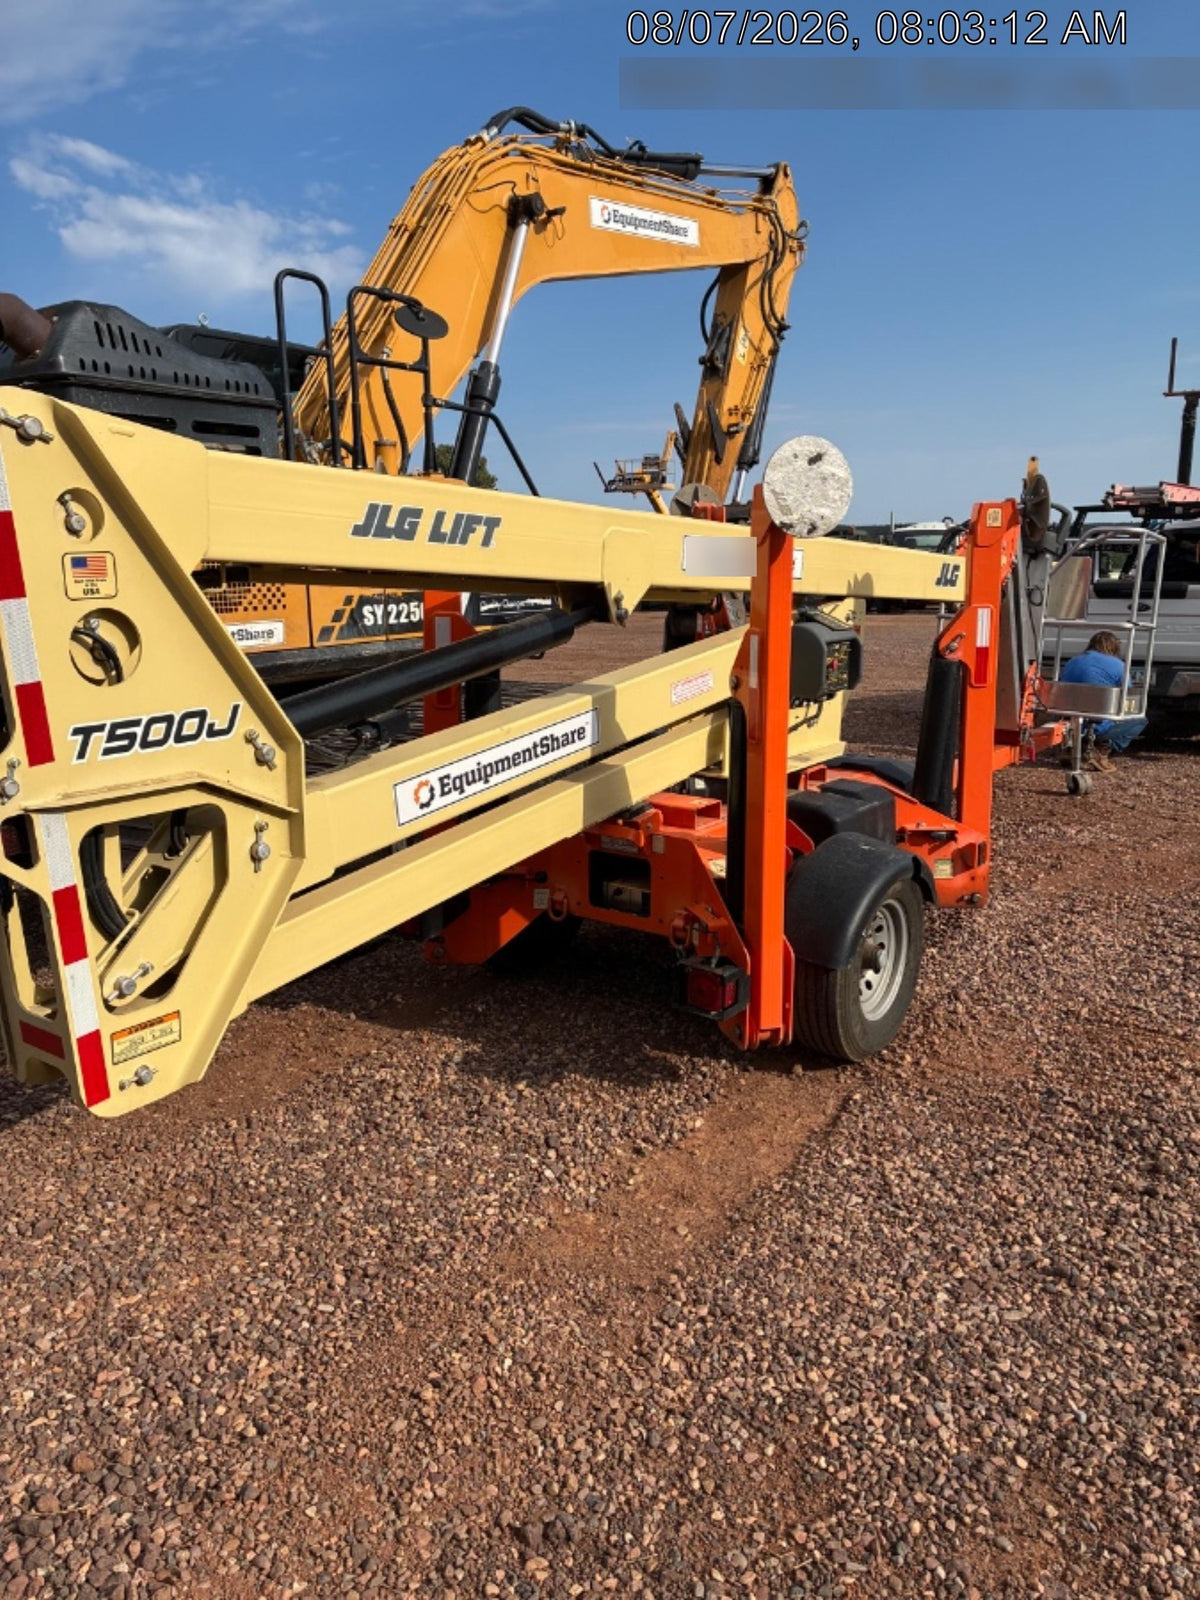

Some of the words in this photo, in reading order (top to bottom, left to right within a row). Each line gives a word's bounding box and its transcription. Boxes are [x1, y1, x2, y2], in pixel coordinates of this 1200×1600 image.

[613, 208, 689, 238] EquipmentShare
[351, 502, 424, 541] JLG
[427, 509, 502, 548] LIFT
[935, 562, 961, 587] JLG
[362, 604, 384, 626] SY
[70, 703, 240, 760] T500J
[438, 722, 586, 798] EquipmentShare
